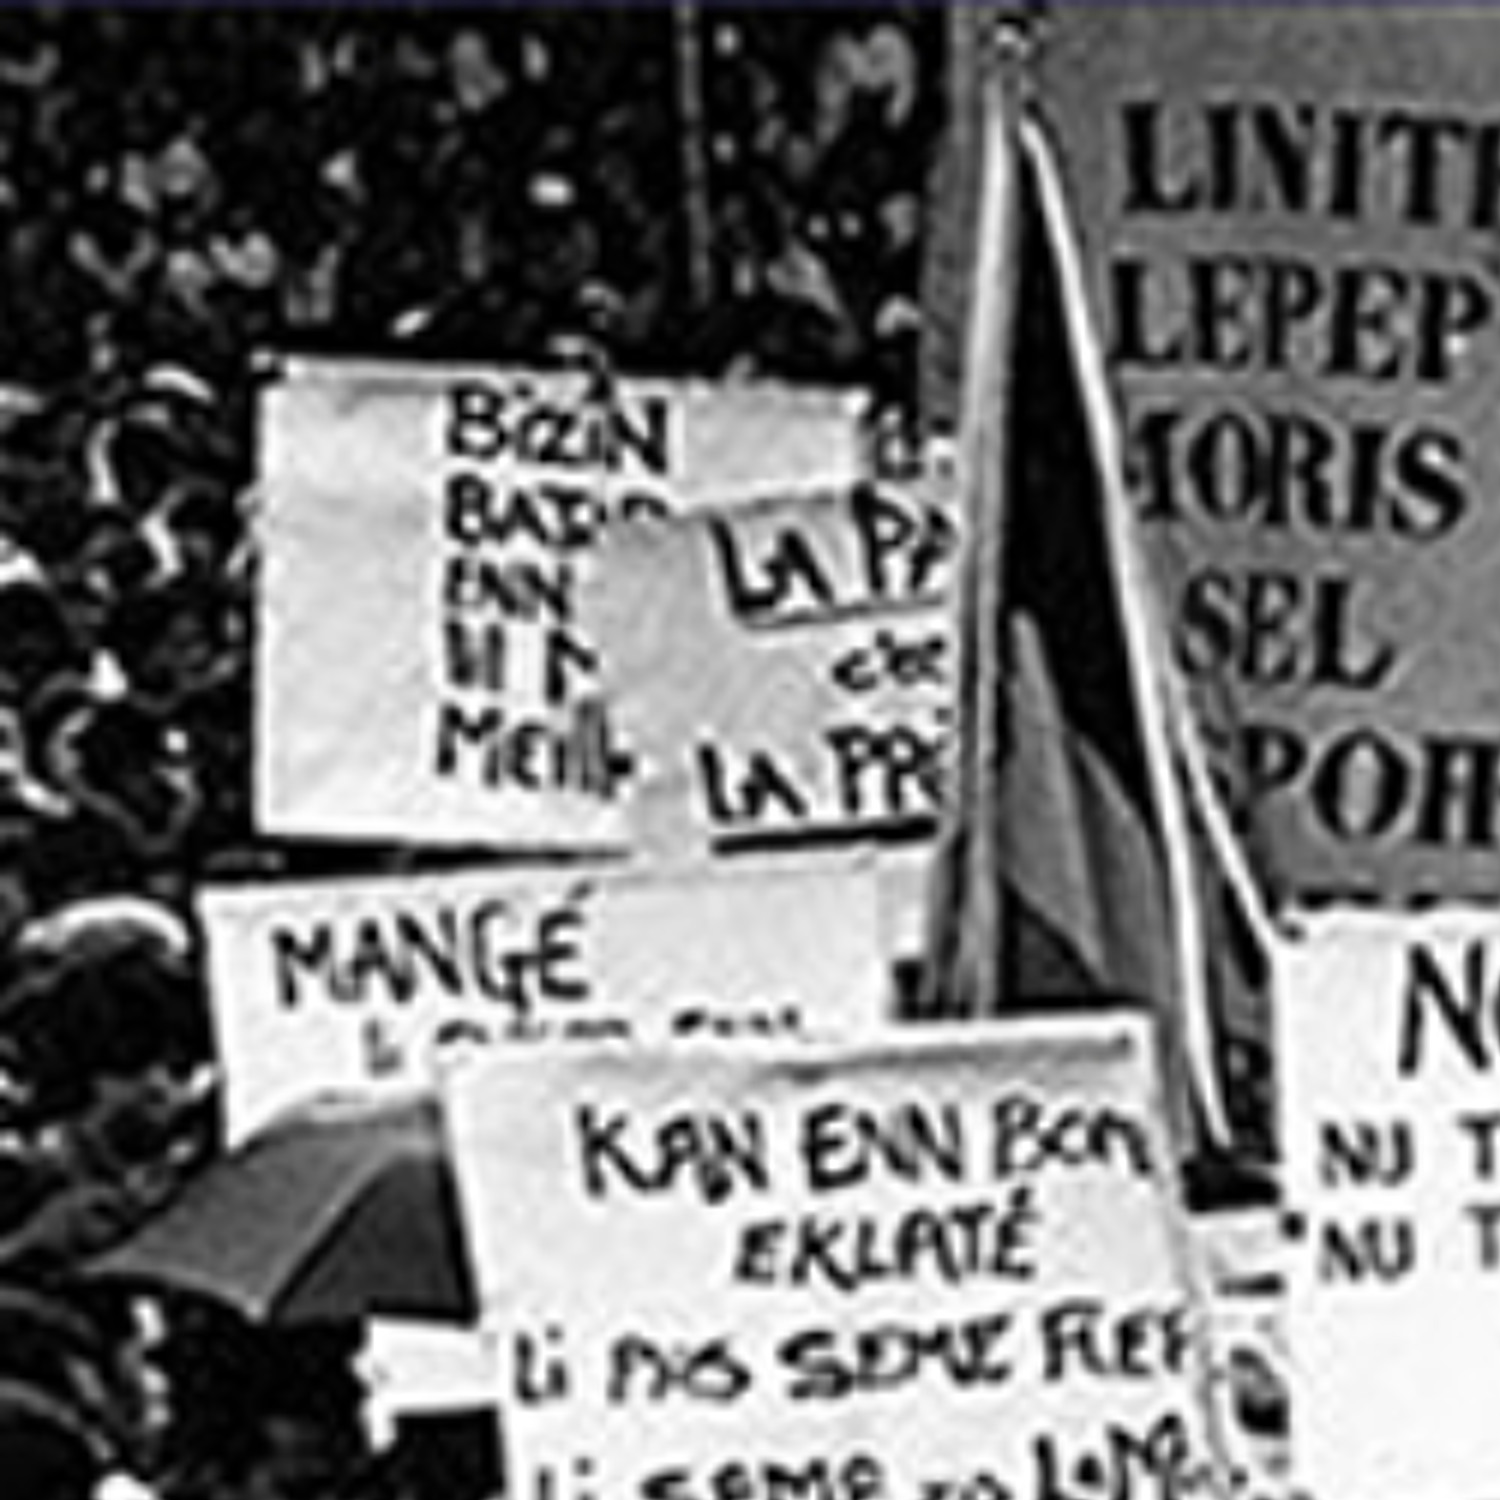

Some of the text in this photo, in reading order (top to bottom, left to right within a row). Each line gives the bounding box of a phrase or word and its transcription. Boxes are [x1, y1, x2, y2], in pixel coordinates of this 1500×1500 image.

[1108, 260, 1495, 382] LEPEP
[1175, 572, 1396, 690] SEL
[272, 882, 592, 1018] MANGÉ
[575, 1103, 776, 1205] KAN
[800, 1103, 966, 1197] ENN
[1318, 1118, 1412, 1187] NU
[733, 1186, 1042, 1293] EKLATÉ
[1318, 1218, 1415, 1285] NU
